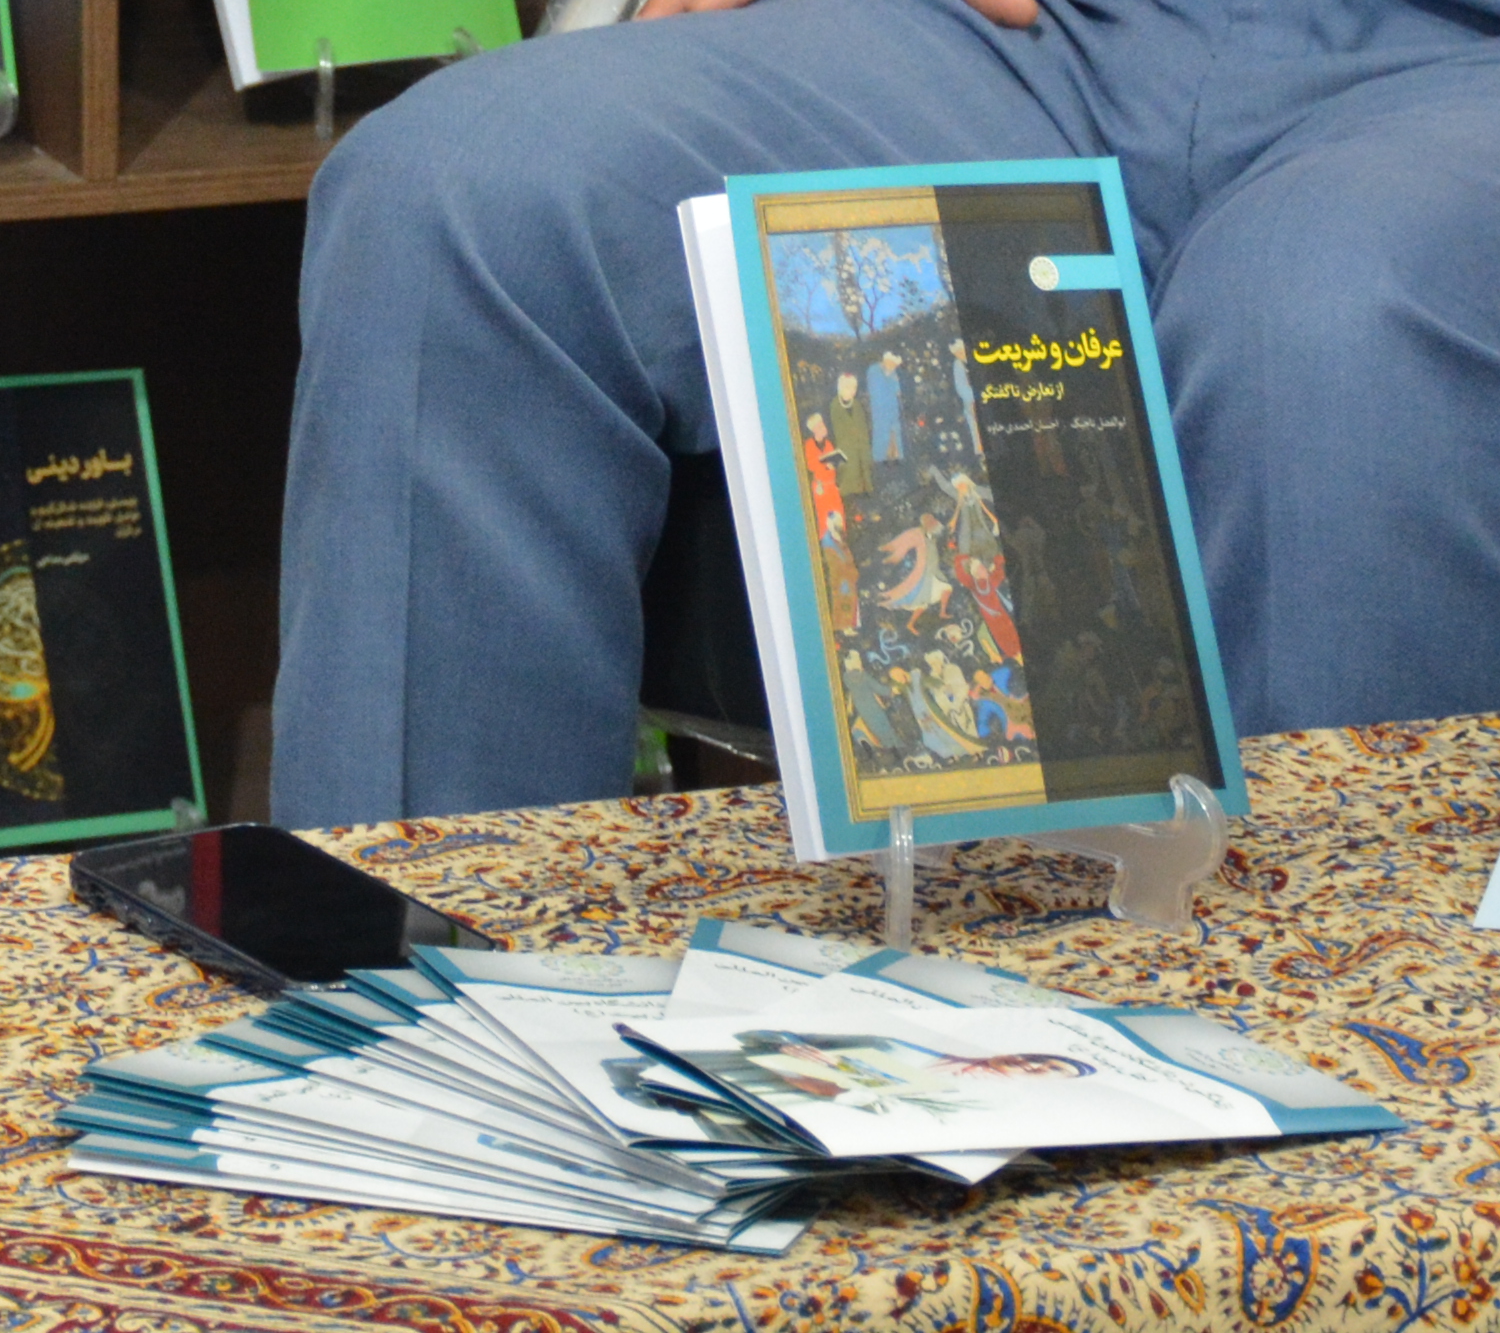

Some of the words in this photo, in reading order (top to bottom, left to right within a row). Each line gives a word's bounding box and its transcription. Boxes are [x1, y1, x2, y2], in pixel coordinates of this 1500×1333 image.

[973, 334, 1047, 372] شریعت
[1050, 341, 1063, 370] و
[1064, 327, 1123, 370] عرفان
[981, 383, 1010, 404] گفتگو
[1010, 383, 1020, 398] تا
[1022, 382, 1055, 403] تعارض
[1056, 381, 1065, 401] از
[26, 455, 79, 486] دینی
[81, 448, 133, 480] باور
